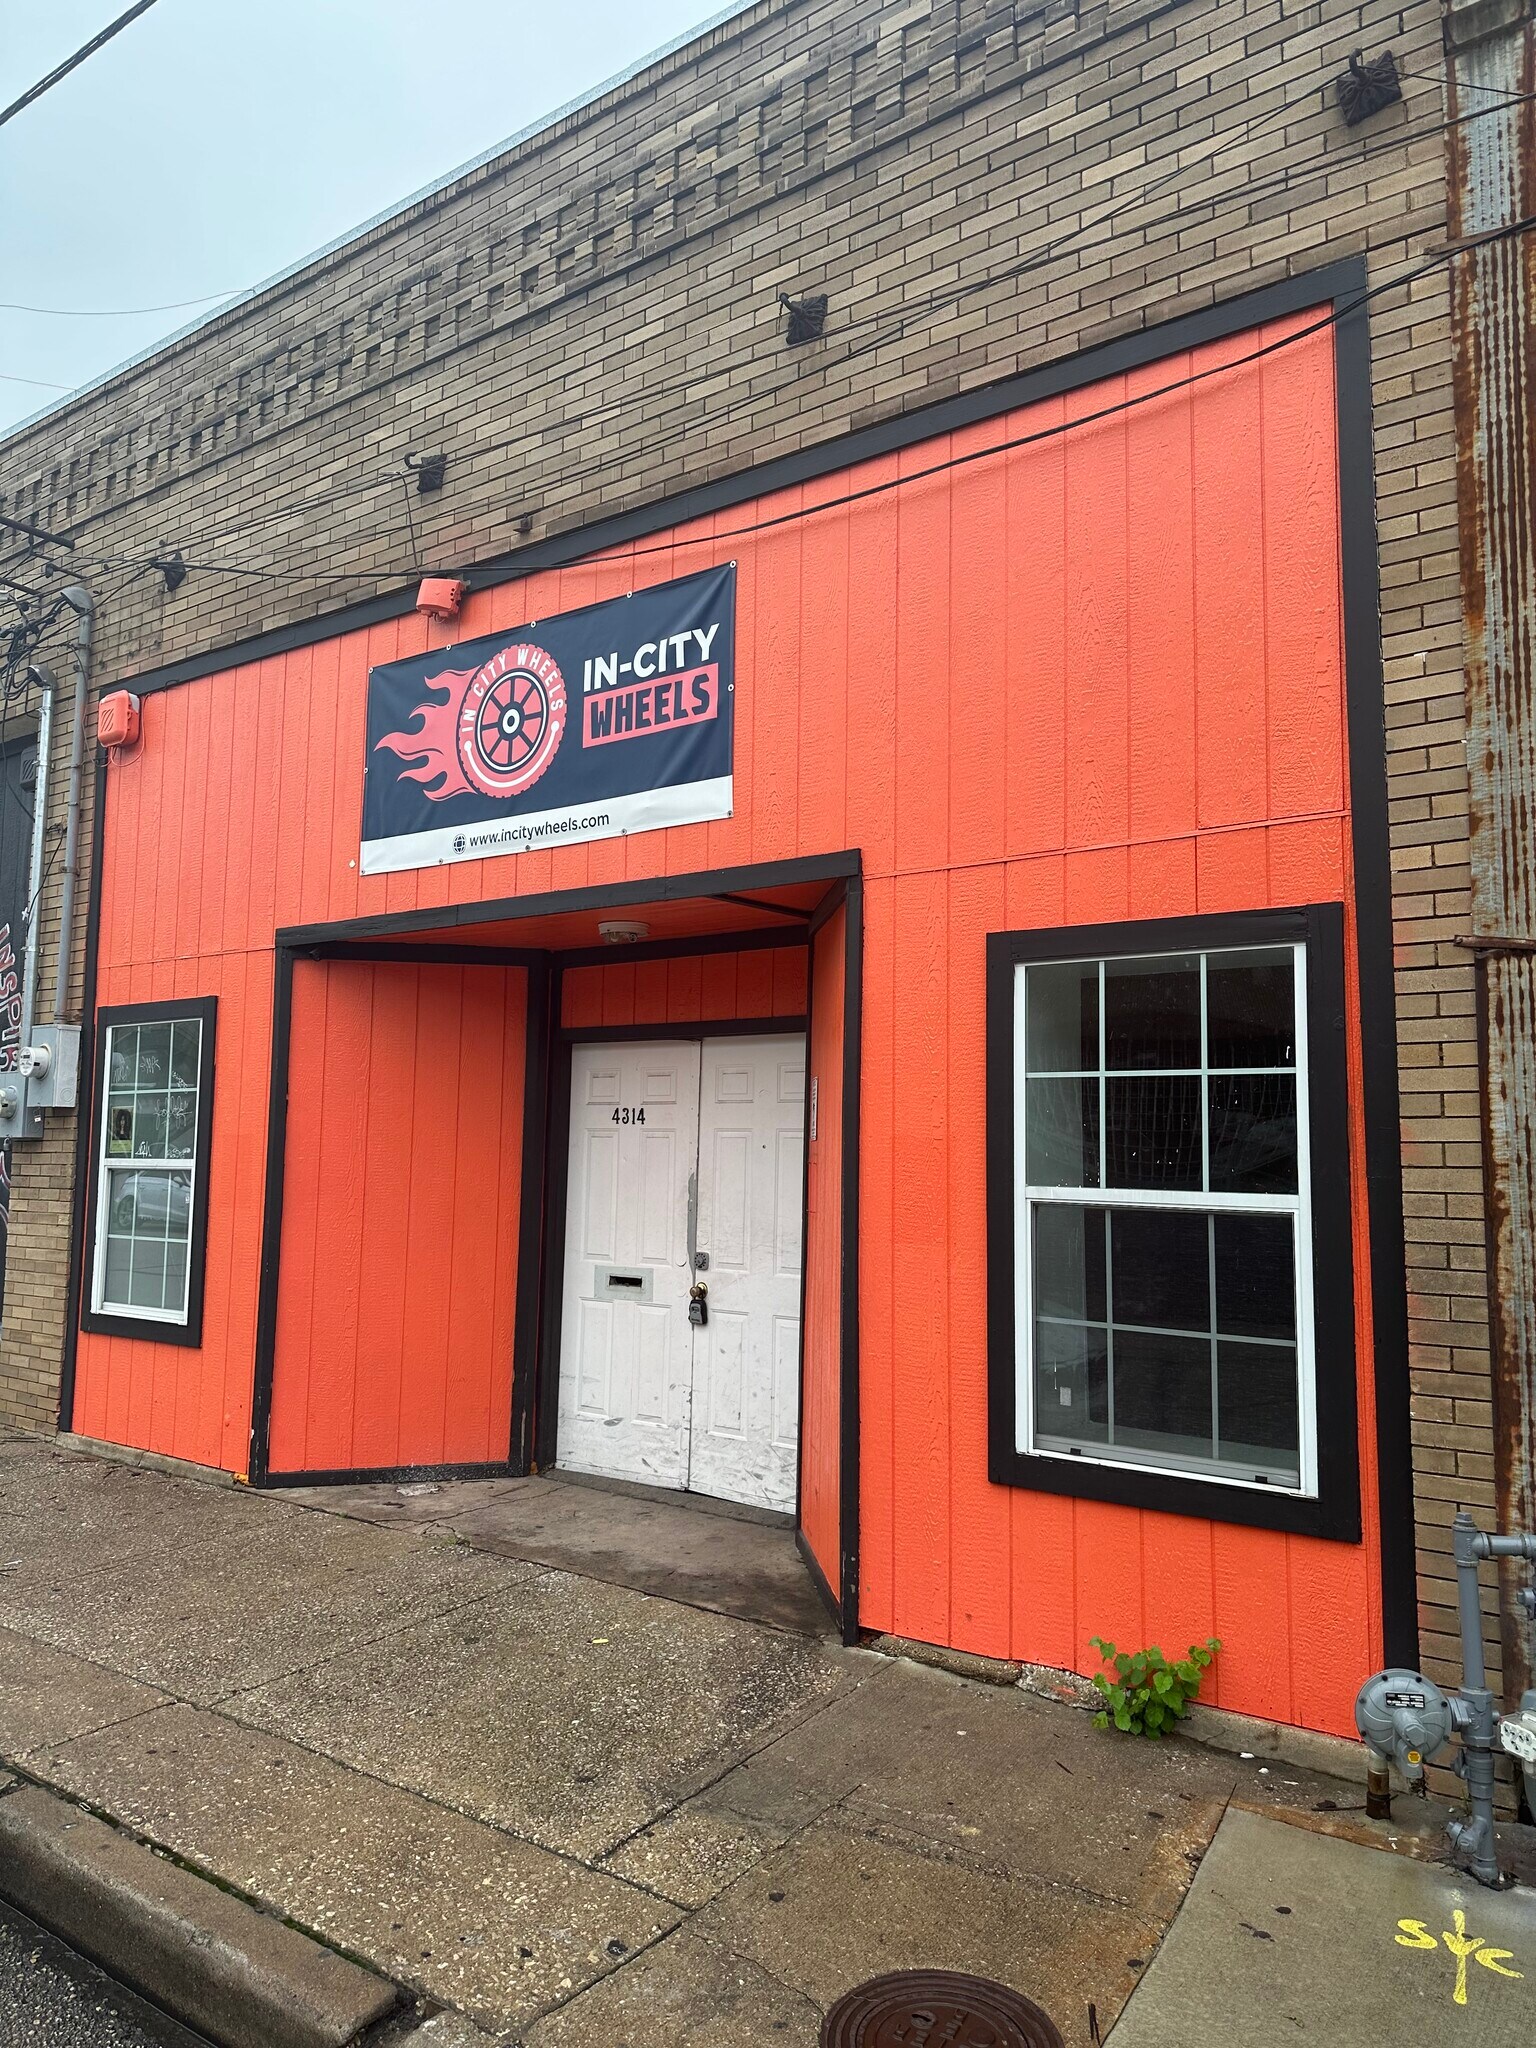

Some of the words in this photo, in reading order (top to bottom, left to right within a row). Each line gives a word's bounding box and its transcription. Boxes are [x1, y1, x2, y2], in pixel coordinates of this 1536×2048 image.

[462, 709, 476, 733] IN
[473, 654, 507, 698] CITY
[517, 648, 564, 712] WHEELS
[584, 623, 720, 692] IN-CITY
[591, 673, 710, 740] WHEELS
[469, 814, 610, 847] www.incitywheels.com
[611, 1107, 646, 1125] 4314
